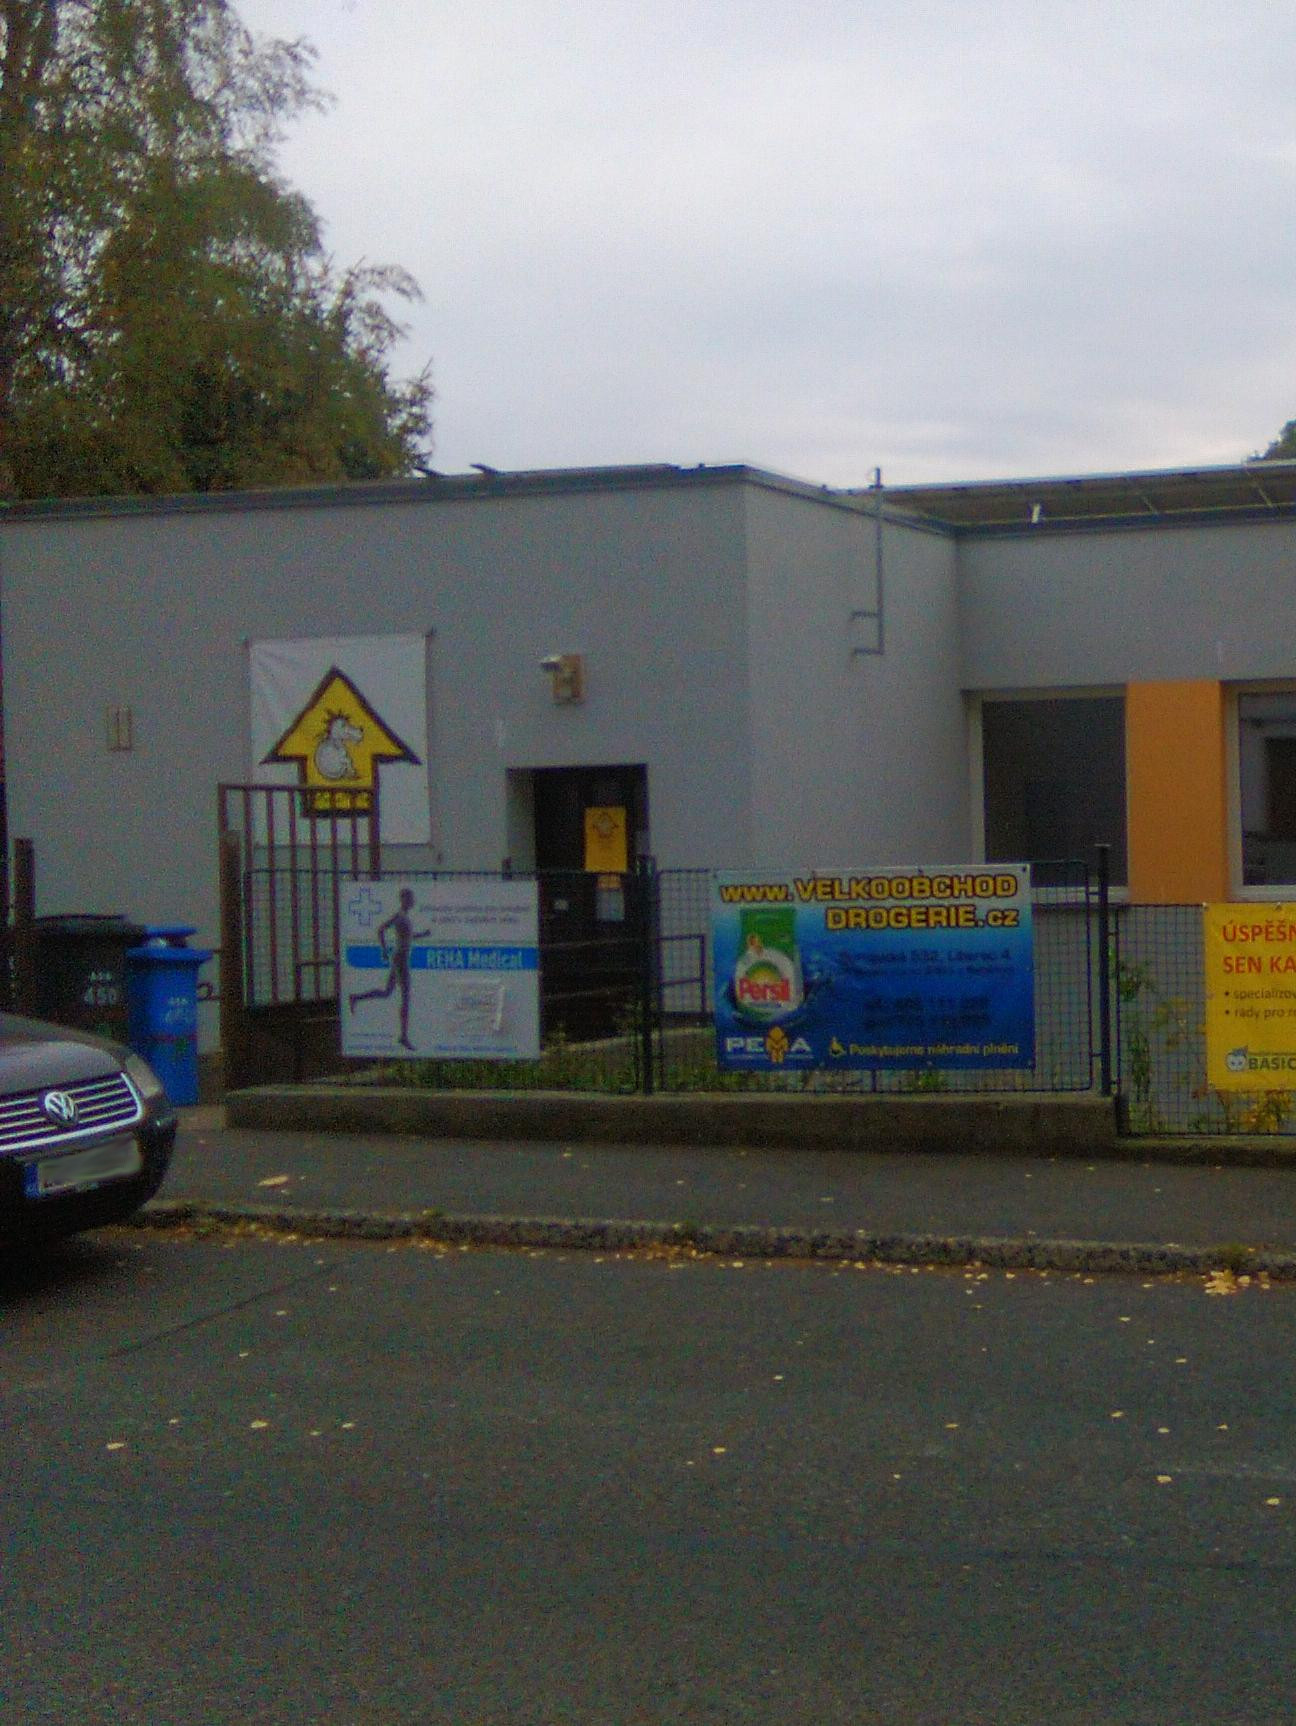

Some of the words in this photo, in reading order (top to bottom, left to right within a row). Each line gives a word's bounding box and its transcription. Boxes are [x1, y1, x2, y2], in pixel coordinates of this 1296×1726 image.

[825, 904, 1019, 931] DROGERIE.cz
[1223, 955, 1262, 974] SEN
[1264, 1008, 1285, 1020] pro
